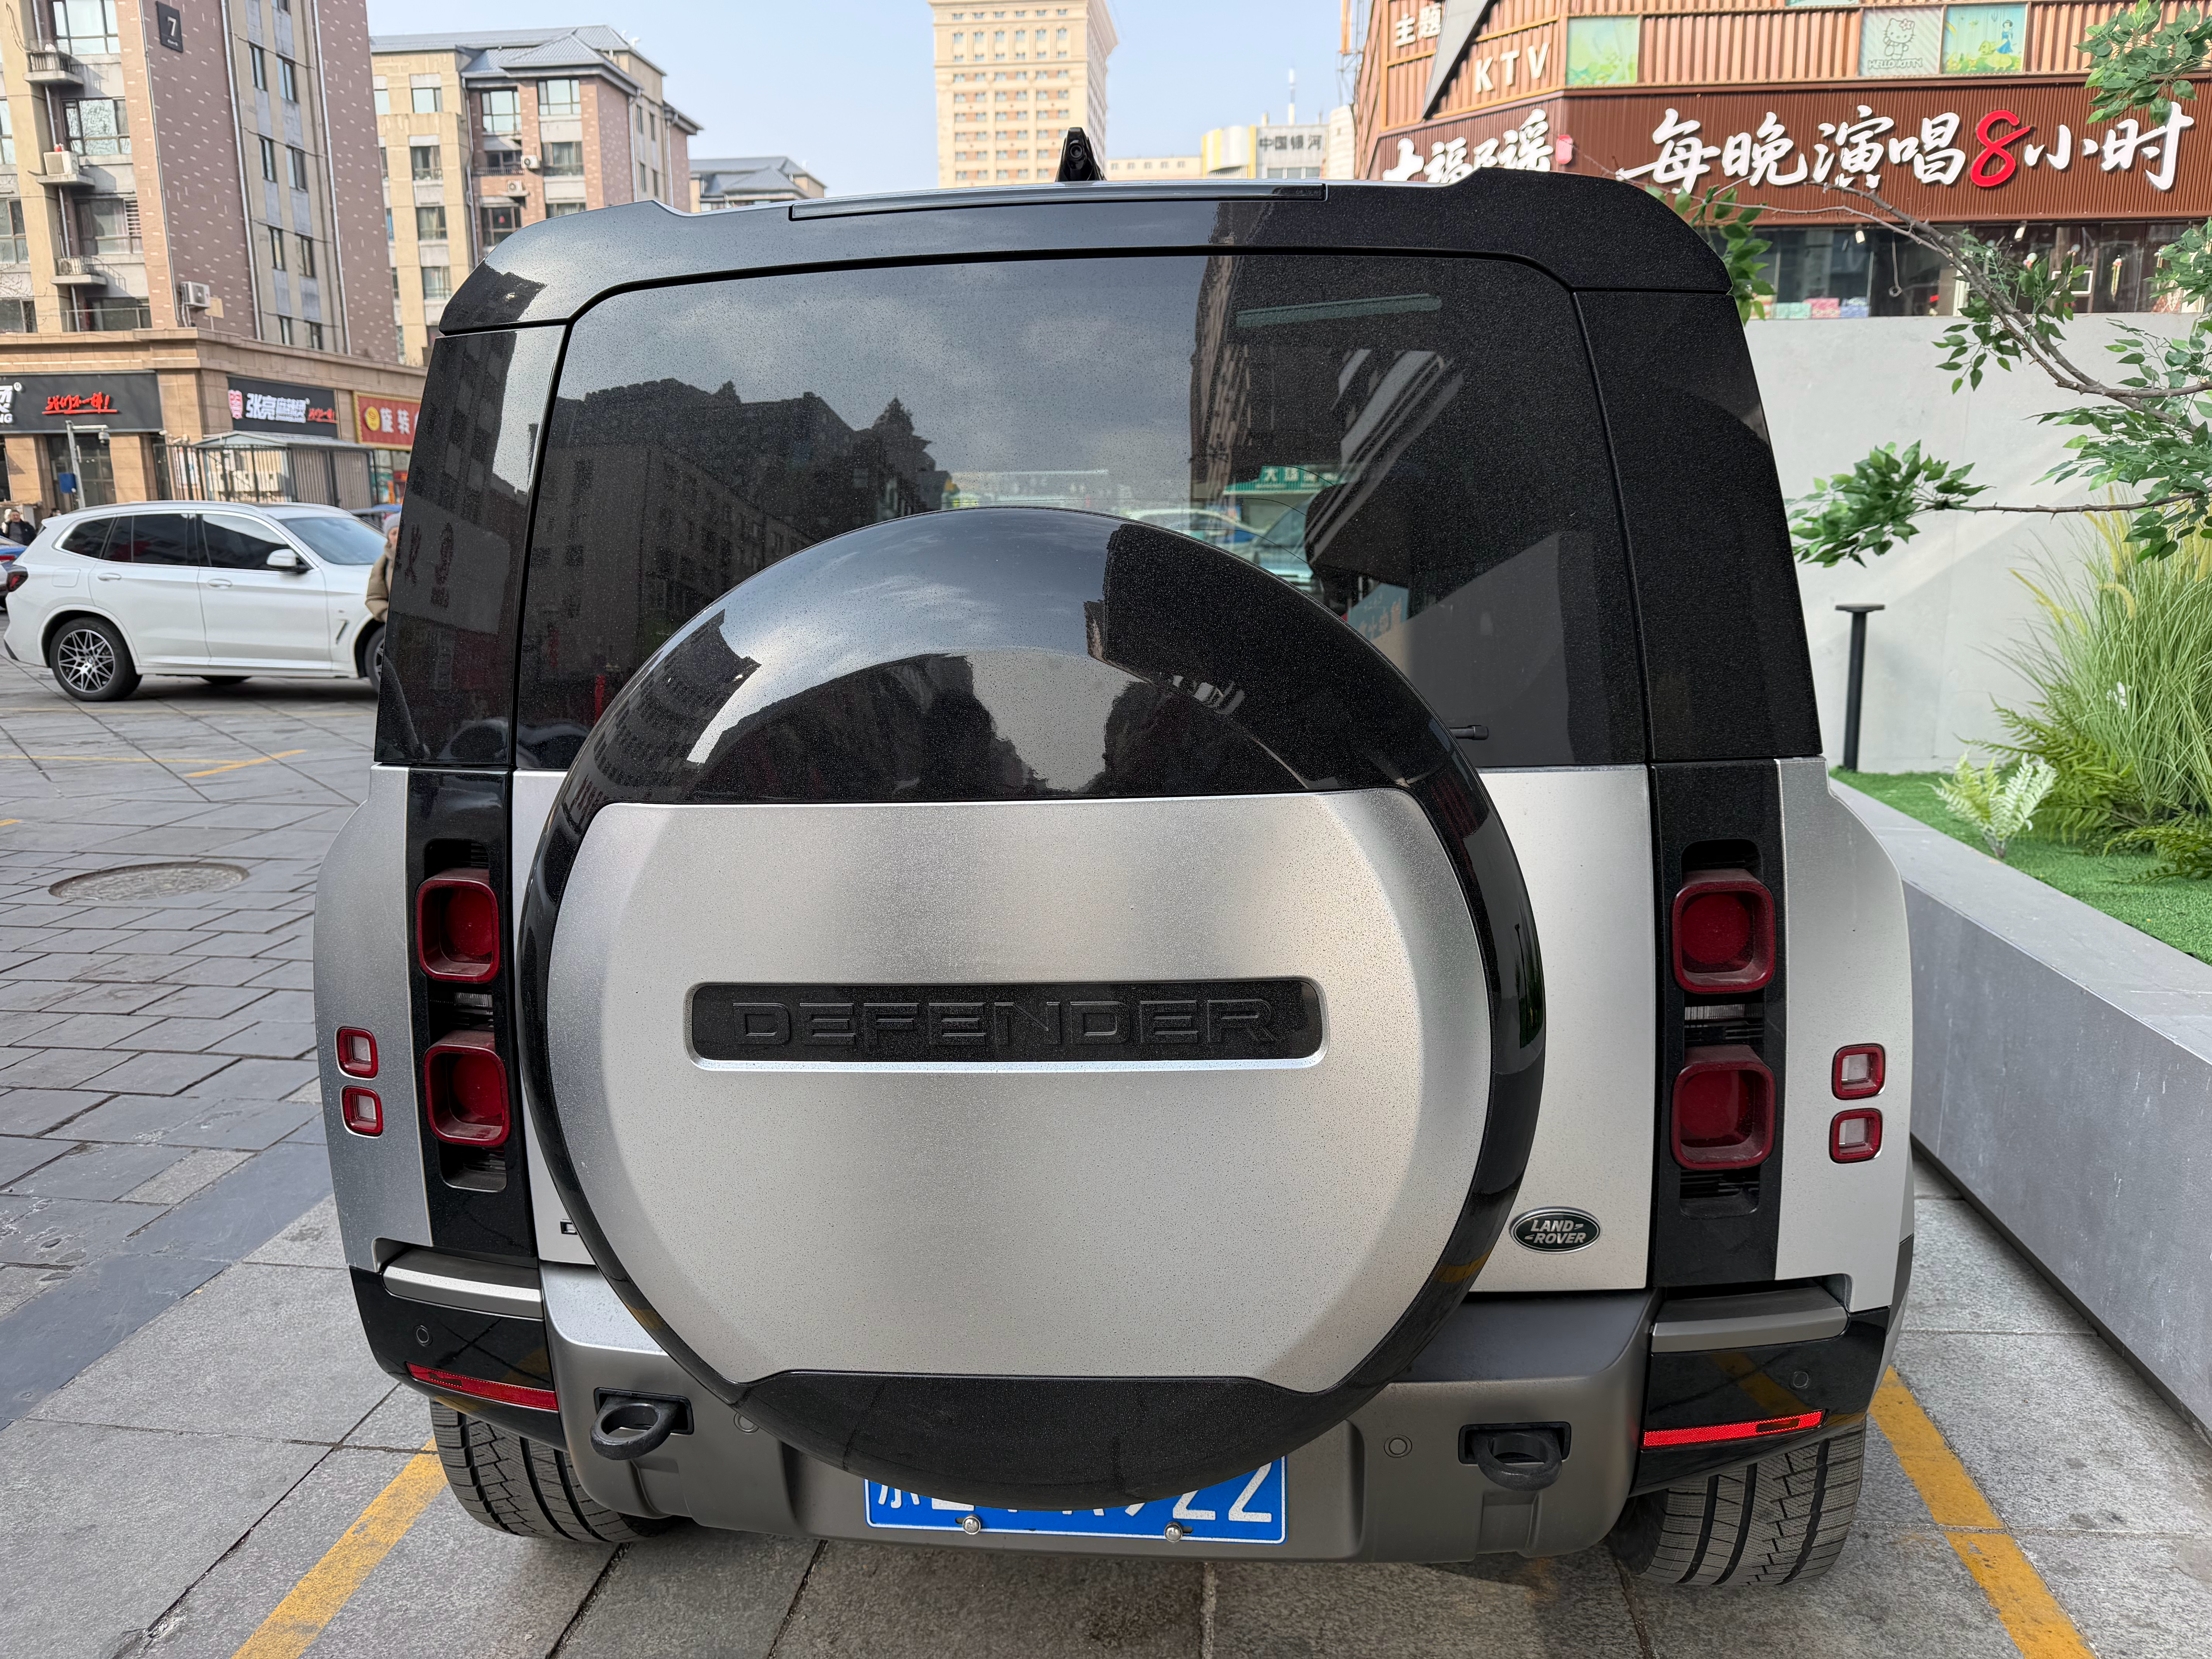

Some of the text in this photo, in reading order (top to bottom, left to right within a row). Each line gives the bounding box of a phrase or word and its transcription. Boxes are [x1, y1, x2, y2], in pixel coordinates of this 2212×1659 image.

[168, 16, 176, 36] 7
[1394, 2, 1441, 47] 主题
[1474, 42, 1549, 93] KTV
[1868, 57, 1923, 69] HELLO KITTY
[1259, 134, 1322, 151] 中国银河
[1615, 101, 2194, 194] 每晚演唱8小时
[380, 407, 419, 435] 旋转
[732, 998, 1279, 1048] DEFENDER
[1530, 1220, 1574, 1232] LAND
[1533, 1232, 1587, 1244] ROVER
